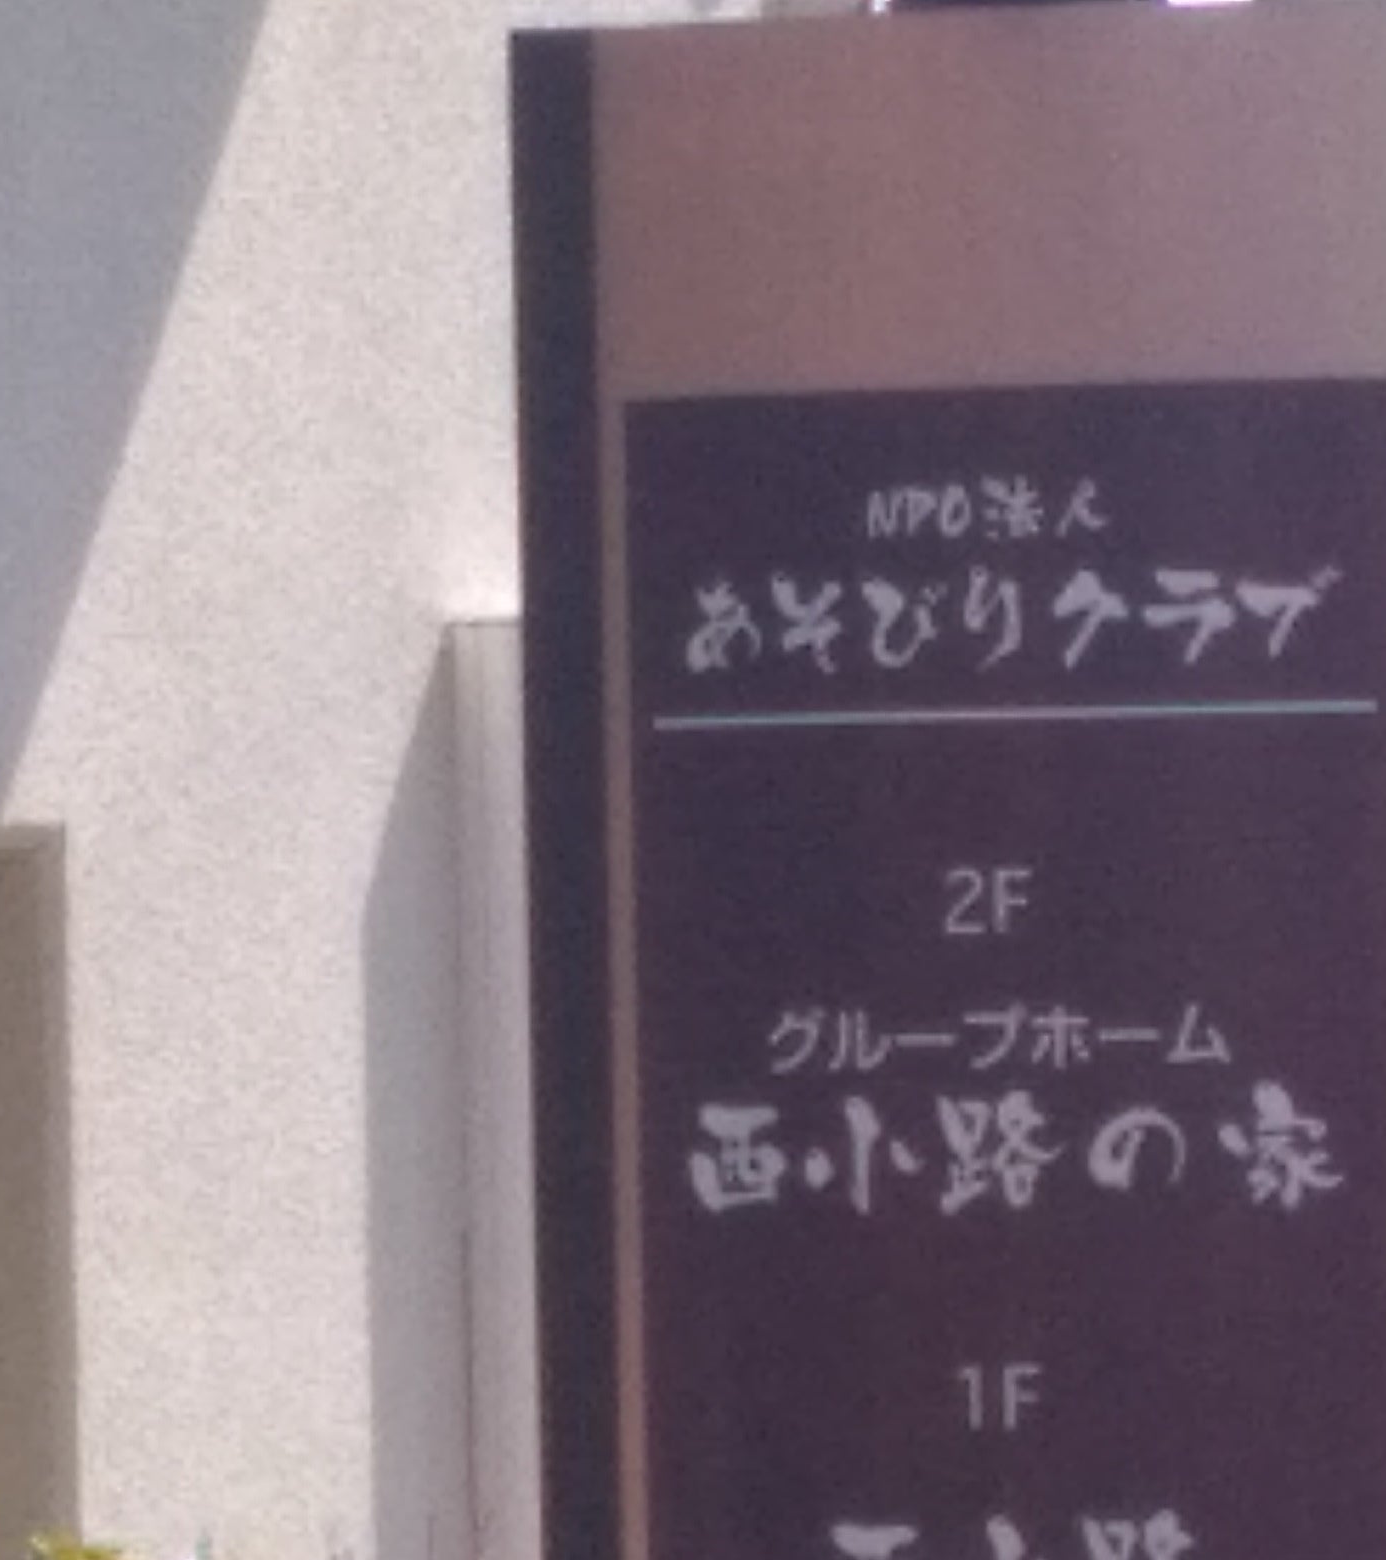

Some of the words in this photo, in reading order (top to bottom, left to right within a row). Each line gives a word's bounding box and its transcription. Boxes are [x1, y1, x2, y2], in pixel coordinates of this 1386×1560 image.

[866, 475, 1108, 540] NPO法人
[686, 564, 1342, 673] あそびりクラブ
[943, 865, 1034, 936] 2F
[768, 1001, 1233, 1074] グループホーム
[687, 1078, 1345, 1215] 西小路の家
[957, 1361, 1043, 1431] 1F
